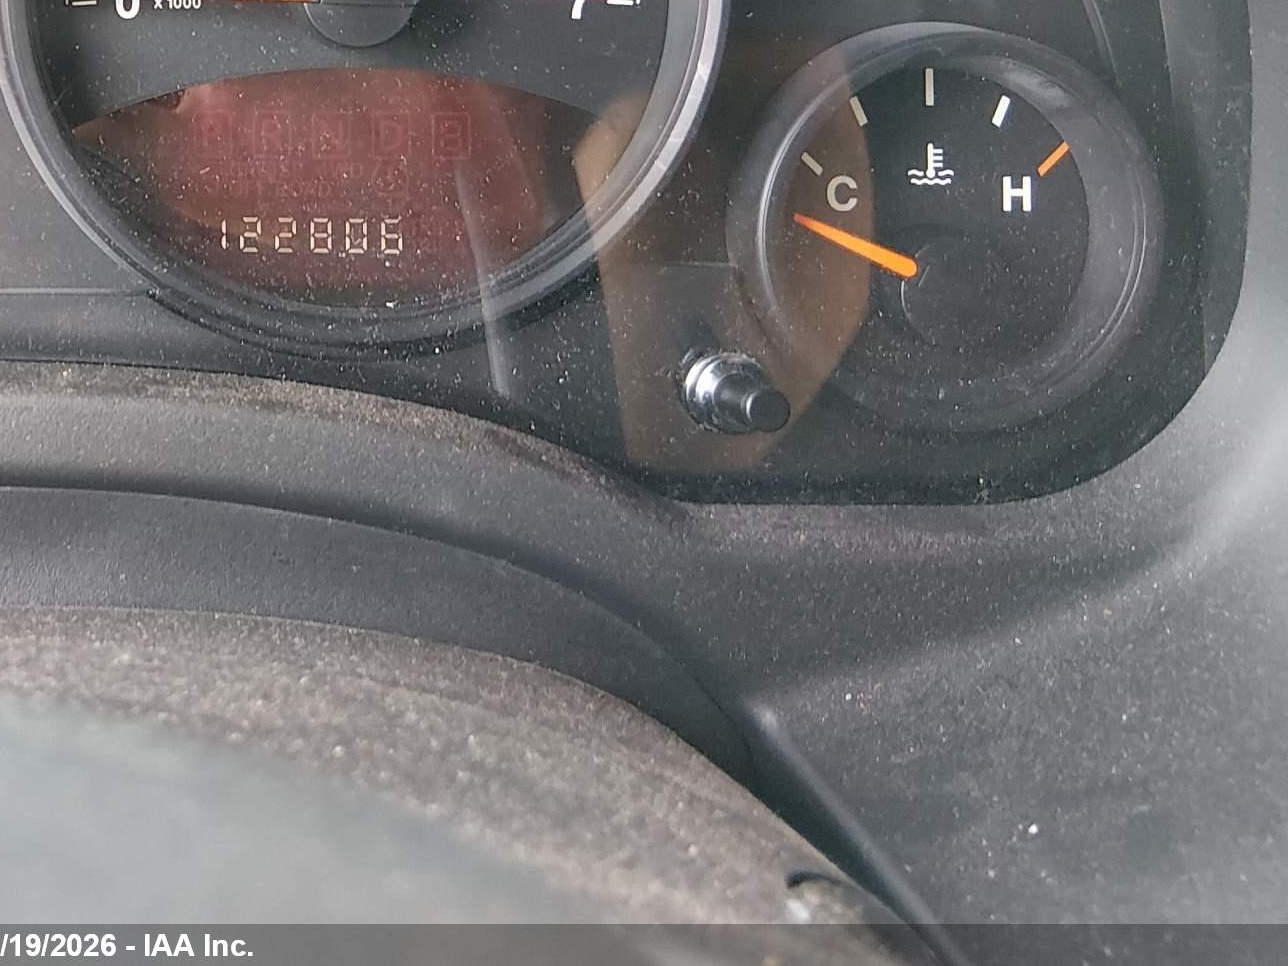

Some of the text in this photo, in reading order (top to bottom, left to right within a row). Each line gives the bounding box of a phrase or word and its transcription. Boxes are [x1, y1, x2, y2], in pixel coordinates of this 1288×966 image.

[826, 175, 858, 212] C
[1002, 175, 1032, 212] H
[220, 215, 403, 255] 122806
